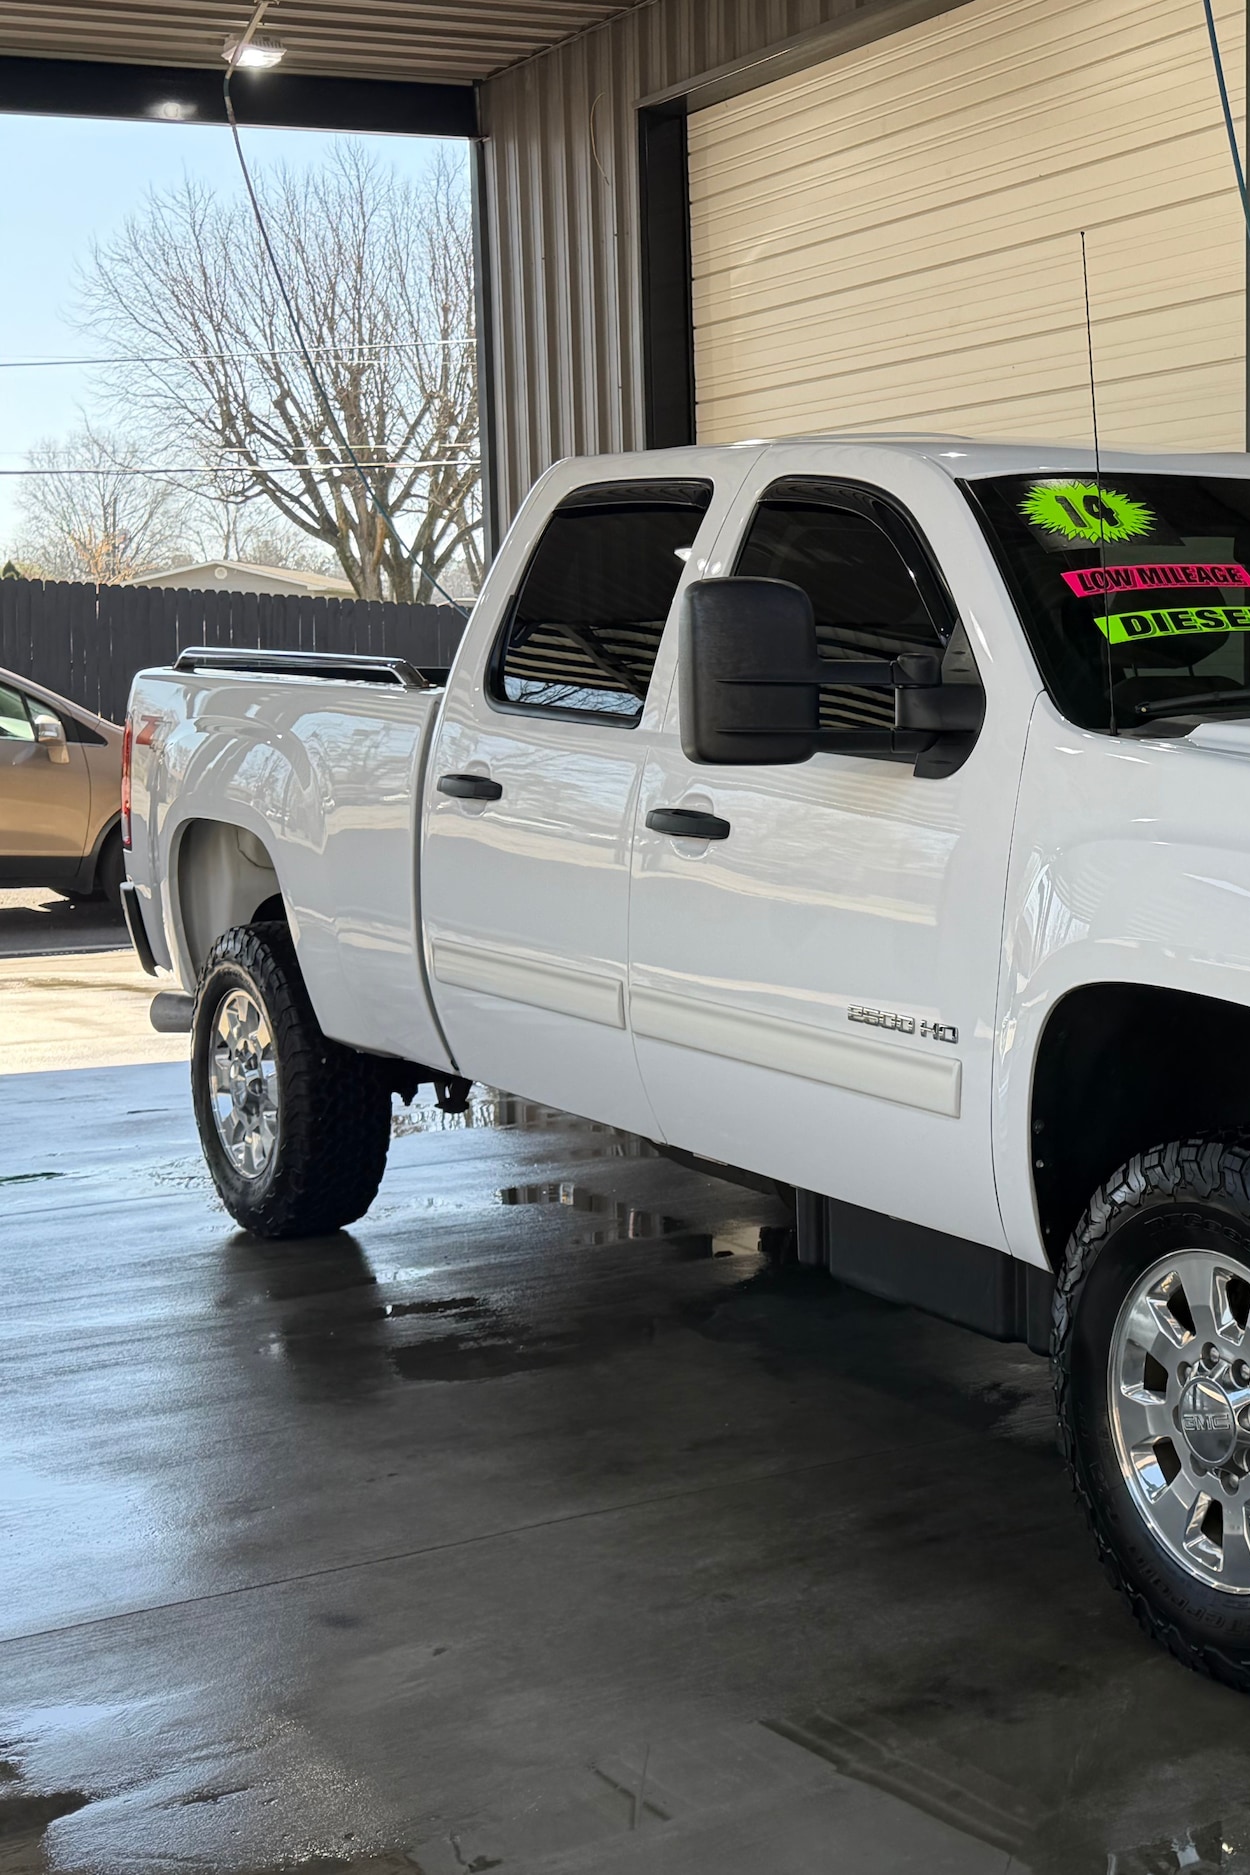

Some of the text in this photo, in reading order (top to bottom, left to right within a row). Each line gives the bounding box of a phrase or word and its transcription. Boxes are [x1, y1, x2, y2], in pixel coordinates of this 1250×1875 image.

[1054, 493, 1121, 528] 14
[1077, 565, 1245, 592] LOW MILEAGE
[920, 1019, 960, 1045] HD
[1183, 1411, 1231, 1431] GMC
